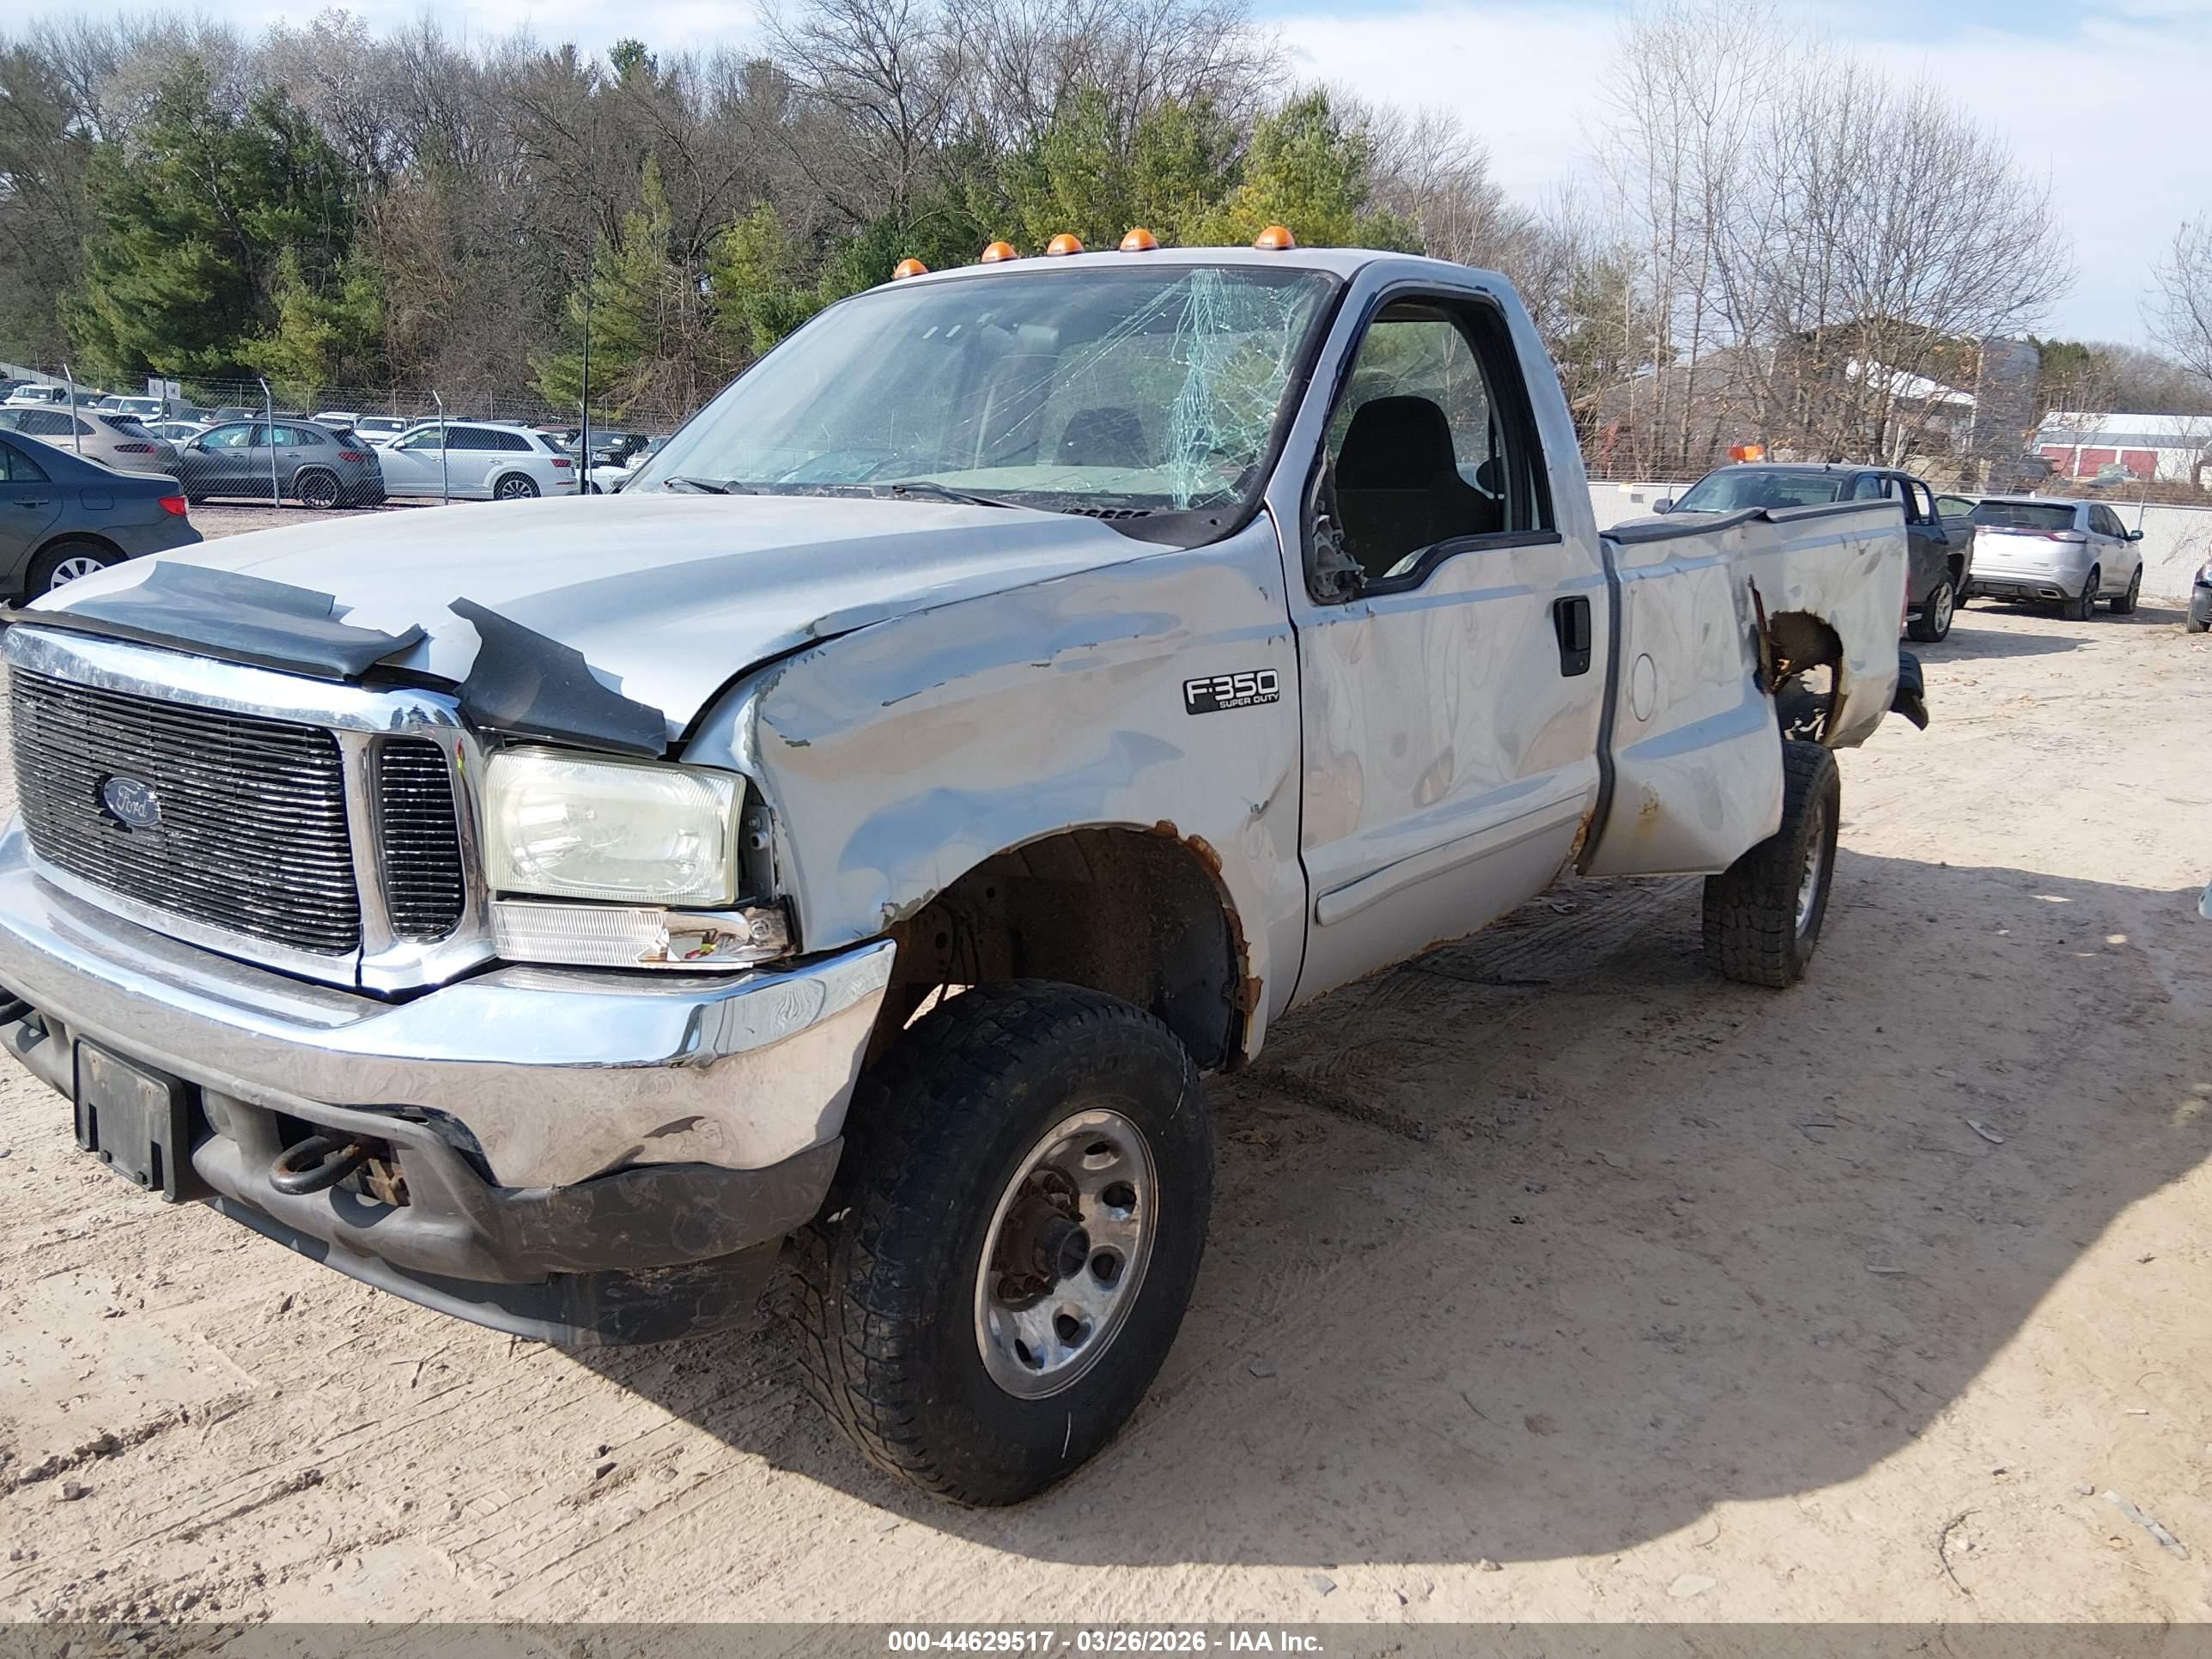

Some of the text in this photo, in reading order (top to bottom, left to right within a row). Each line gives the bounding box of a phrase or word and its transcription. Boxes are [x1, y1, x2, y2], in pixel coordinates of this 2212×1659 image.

[1186, 670, 1279, 705] F-350
[1219, 692, 1279, 708] SUPER DUTY
[116, 785, 149, 817] Ford
